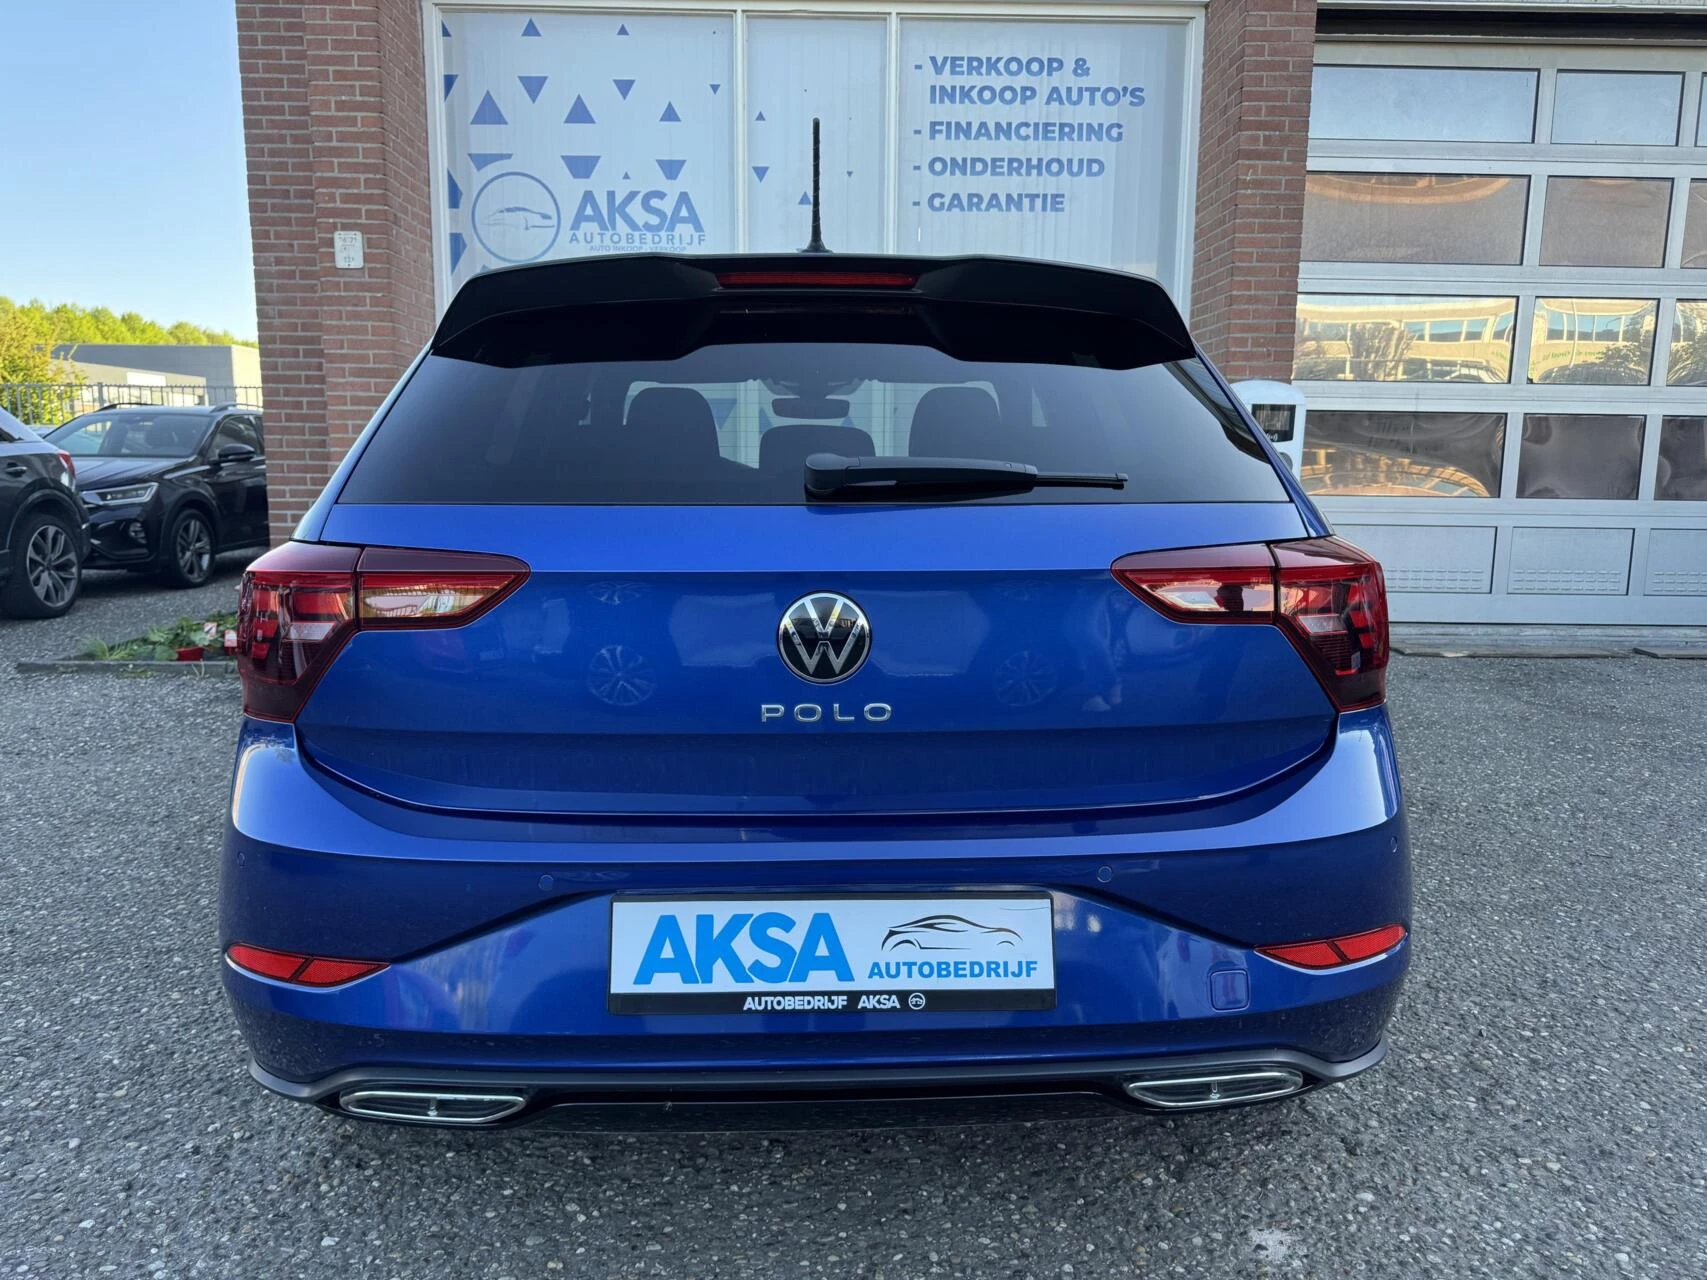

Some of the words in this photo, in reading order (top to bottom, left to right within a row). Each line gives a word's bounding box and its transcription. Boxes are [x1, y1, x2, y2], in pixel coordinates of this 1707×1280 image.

[929, 56, 1064, 78] VERKOOP
[1072, 57, 1091, 78] &
[929, 85, 1037, 105] INKOOP
[1045, 86, 1146, 107] AUTO'S
[929, 121, 1124, 142] FINANCIERING
[928, 157, 1105, 177] ONDERHOUD
[570, 190, 705, 233] AKSA
[927, 192, 1066, 212] GARANTIE
[569, 232, 707, 246] AUTOBEDRIJF
[761, 703, 892, 723] POLO
[633, 912, 856, 985] AKSA
[867, 960, 1039, 979] AUTOBEDRIJF
[743, 996, 848, 1011] AUTOBEDRIJF
[858, 995, 901, 1009] AKSA
